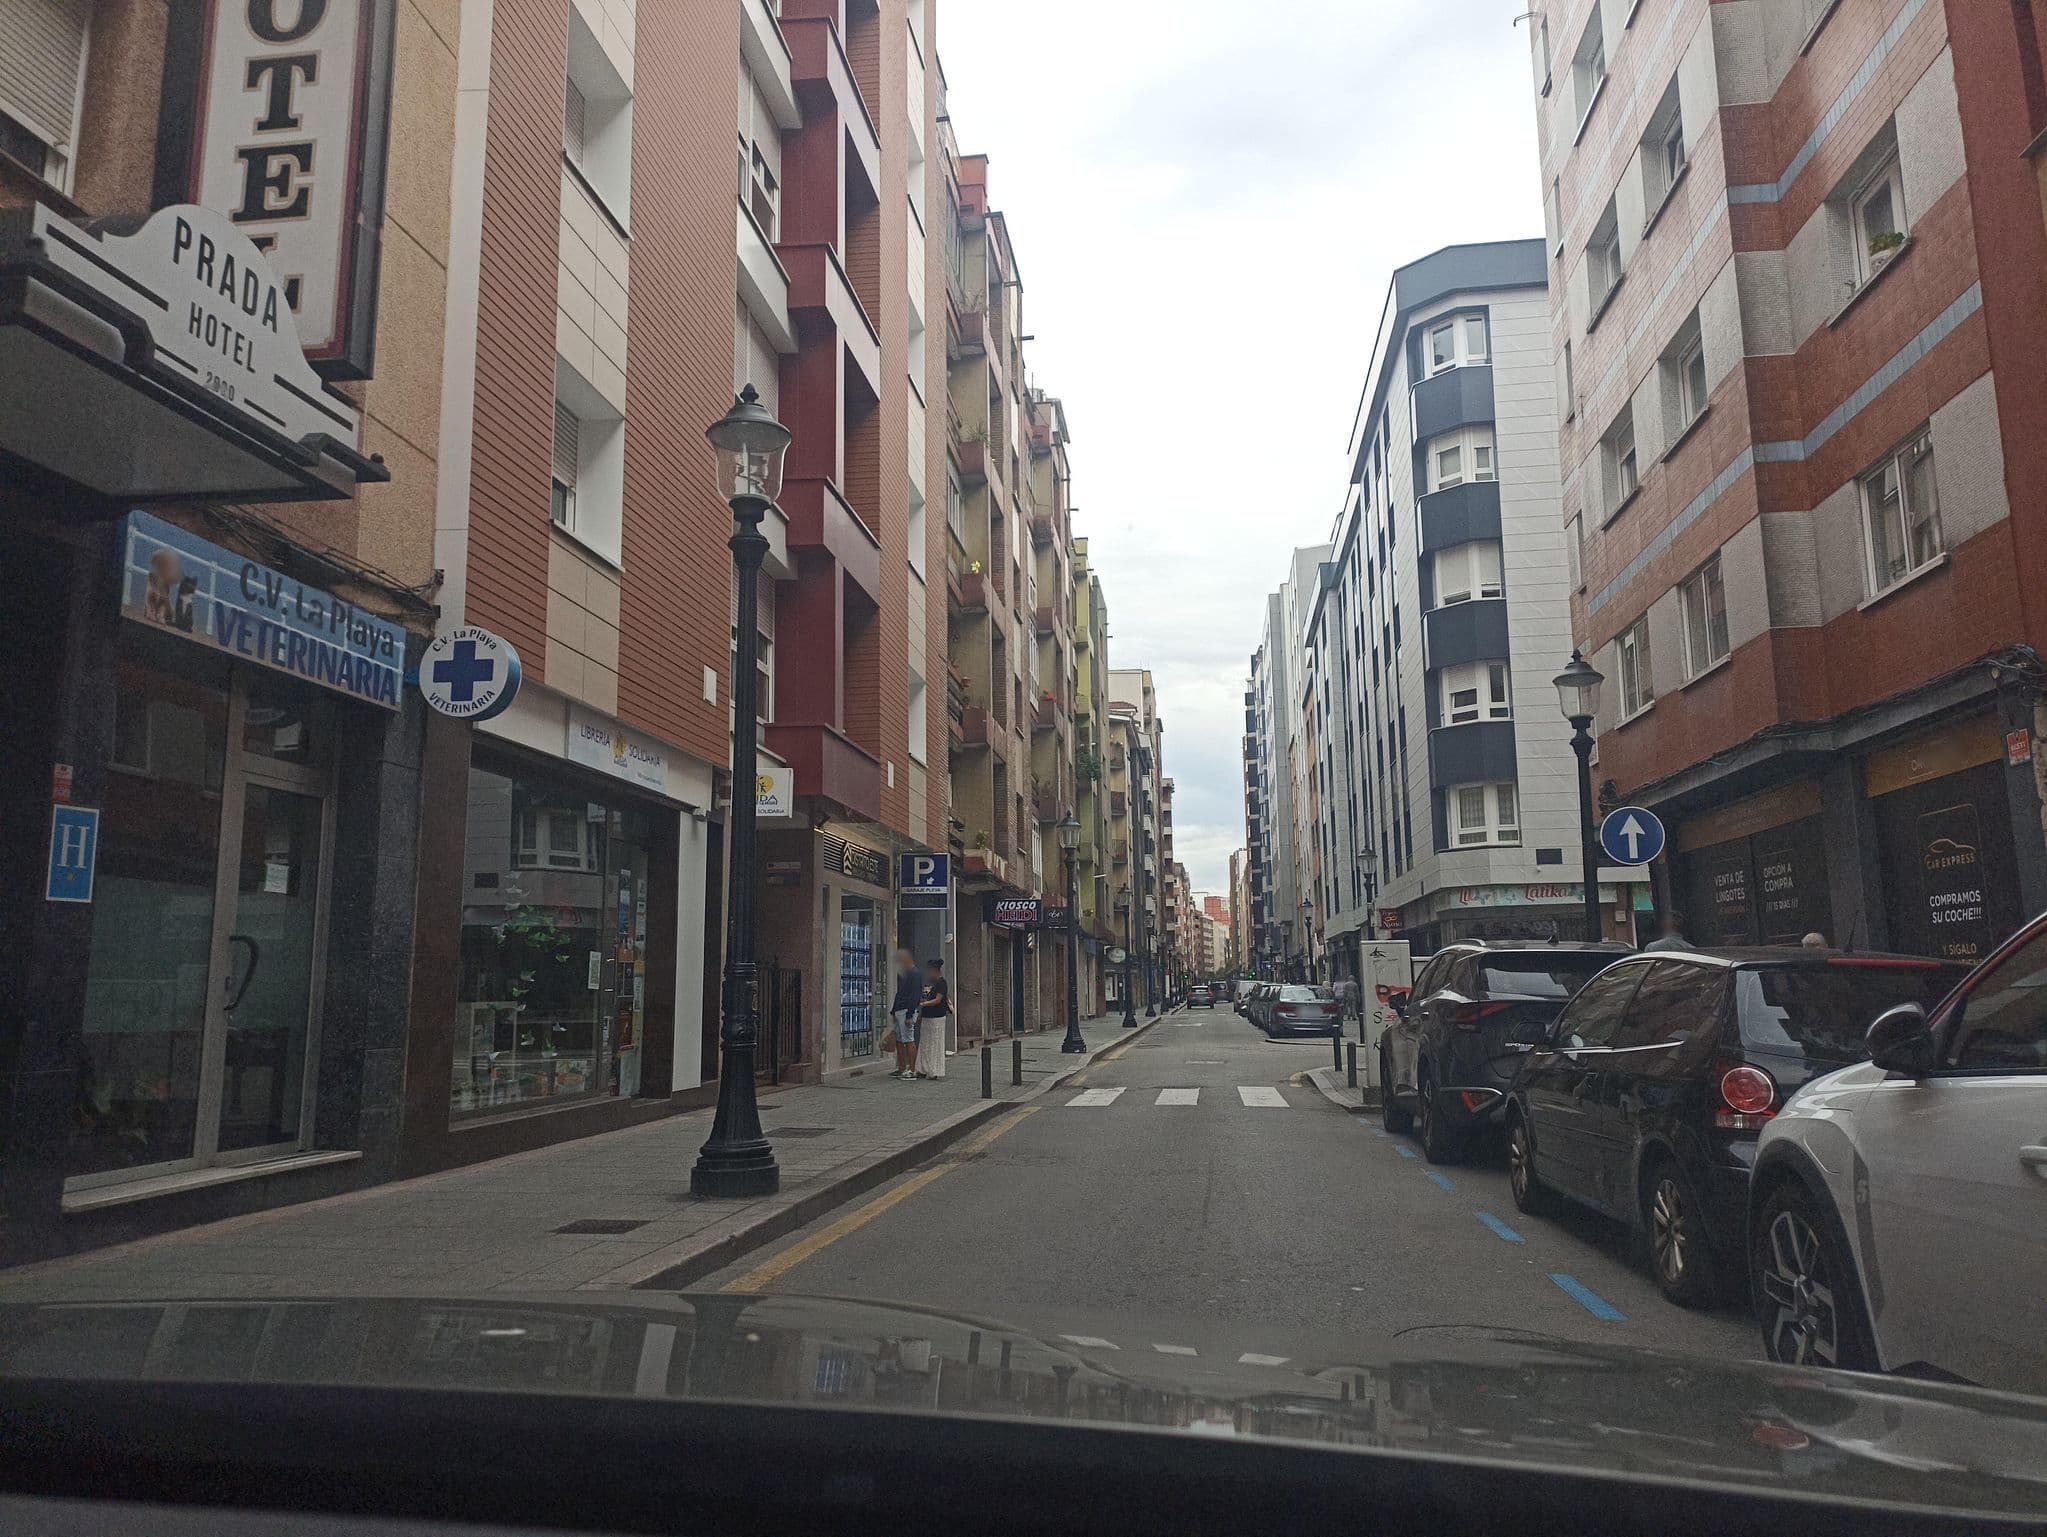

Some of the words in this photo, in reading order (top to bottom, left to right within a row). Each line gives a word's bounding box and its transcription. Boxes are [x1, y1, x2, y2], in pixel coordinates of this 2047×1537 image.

[233, 0, 327, 313] OTE
[173, 216, 277, 333] PRADA
[189, 301, 255, 374] HOTEL
[240, 562, 288, 616] C.V.
[297, 586, 323, 627] La
[330, 599, 394, 659] Playa
[432, 636, 452, 652] C.V.
[454, 630, 466, 639] La
[470, 629, 497, 650] Playa
[215, 602, 396, 705] VETERINARIA
[429, 690, 495, 713] VETERINARIA
[629, 743, 660, 768] SOLIDARIA
[57, 824, 90, 868] H
[913, 856, 935, 886] P
[1942, 853, 1975, 867] EXPRESS
[1713, 872, 1734, 887] VENTA
[1735, 870, 1744, 883] DE
[1765, 876, 1794, 892] COMPRA
[996, 901, 1036, 911] KIOSCO
[1716, 888, 1745, 903] LINGOTES
[1929, 890, 1981, 907] COMPRAMOS
[1932, 910, 1943, 923] SU
[1944, 907, 1982, 922] COCHE!!!
